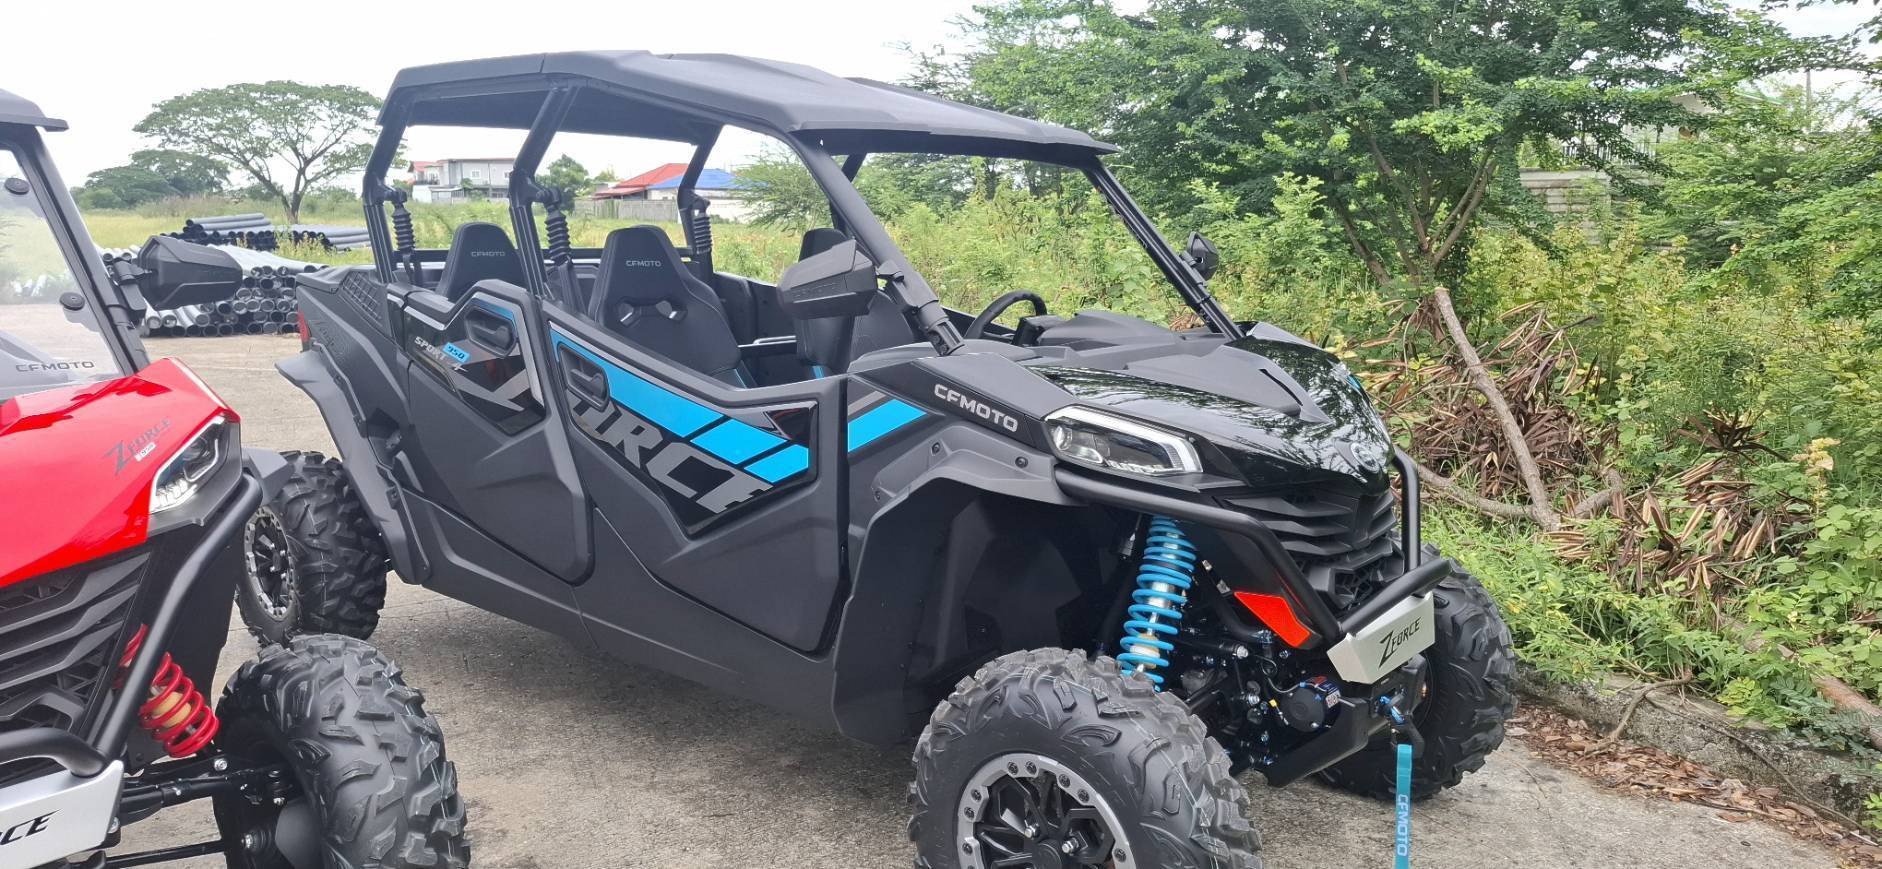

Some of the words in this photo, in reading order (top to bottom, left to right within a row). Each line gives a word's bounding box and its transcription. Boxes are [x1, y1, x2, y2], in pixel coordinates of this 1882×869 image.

[15, 361, 95, 373] CFMOTO
[934, 383, 1018, 433] CFMOTO
[1379, 616, 1422, 668] ZFORCE
[0, 811, 62, 846] CE
[1396, 793, 1409, 857] CFMOTO
